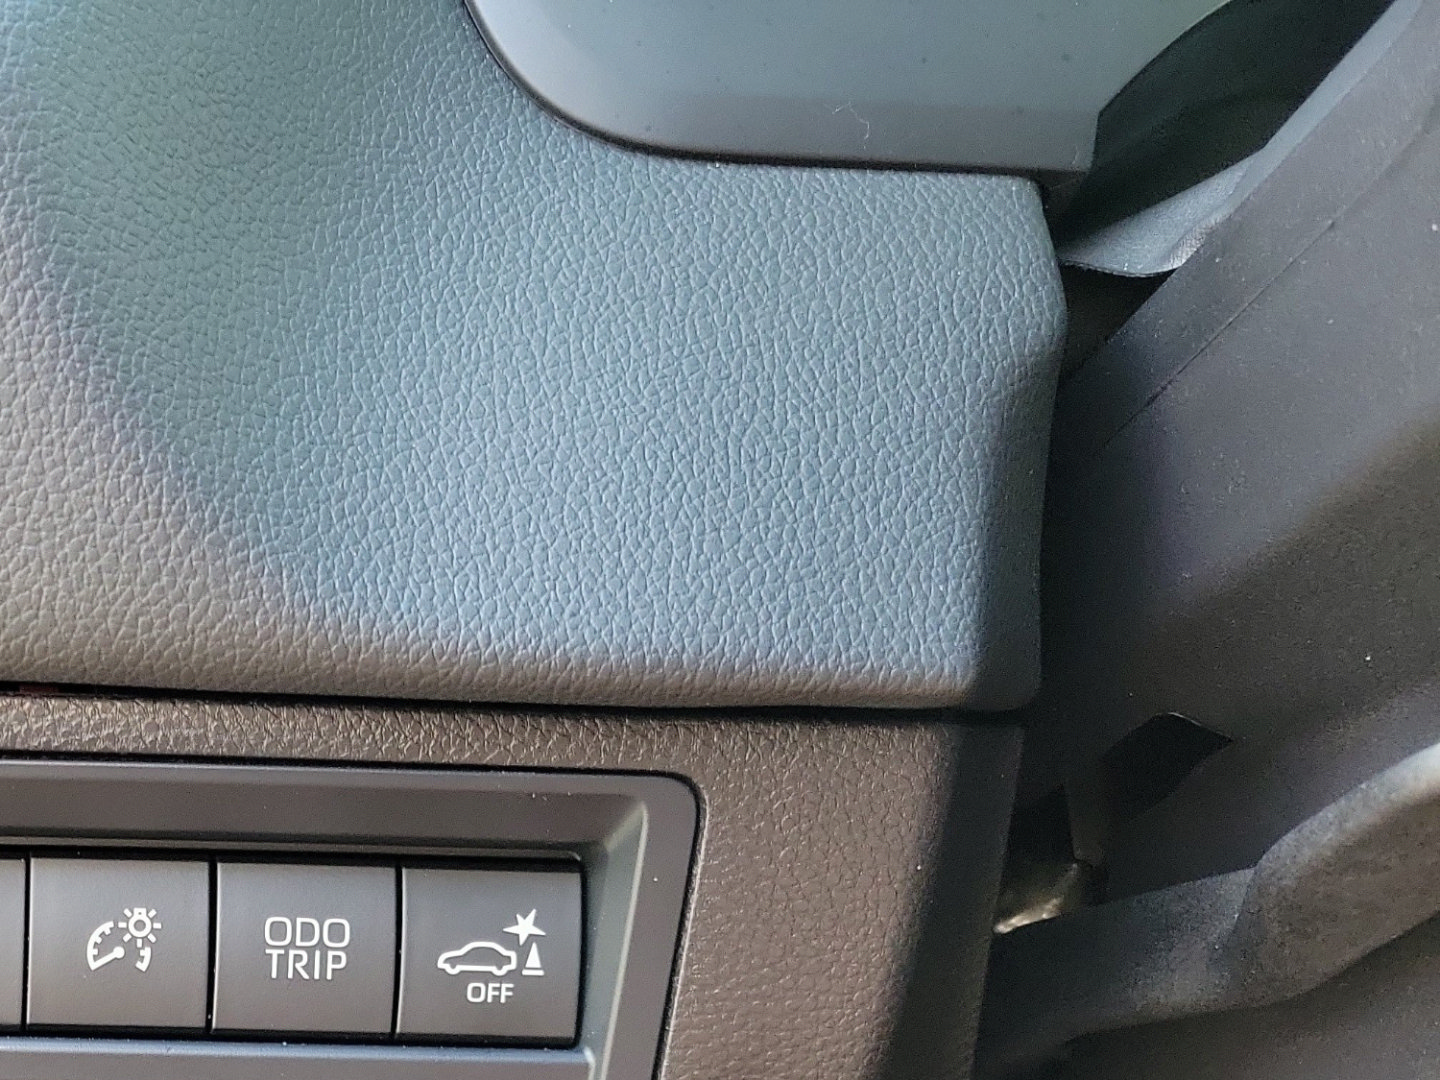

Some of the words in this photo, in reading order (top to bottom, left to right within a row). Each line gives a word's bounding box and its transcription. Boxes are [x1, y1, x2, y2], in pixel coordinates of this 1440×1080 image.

[264, 916, 351, 948] ODO
[265, 948, 348, 981] TRIP
[466, 983, 514, 1004] OFF
